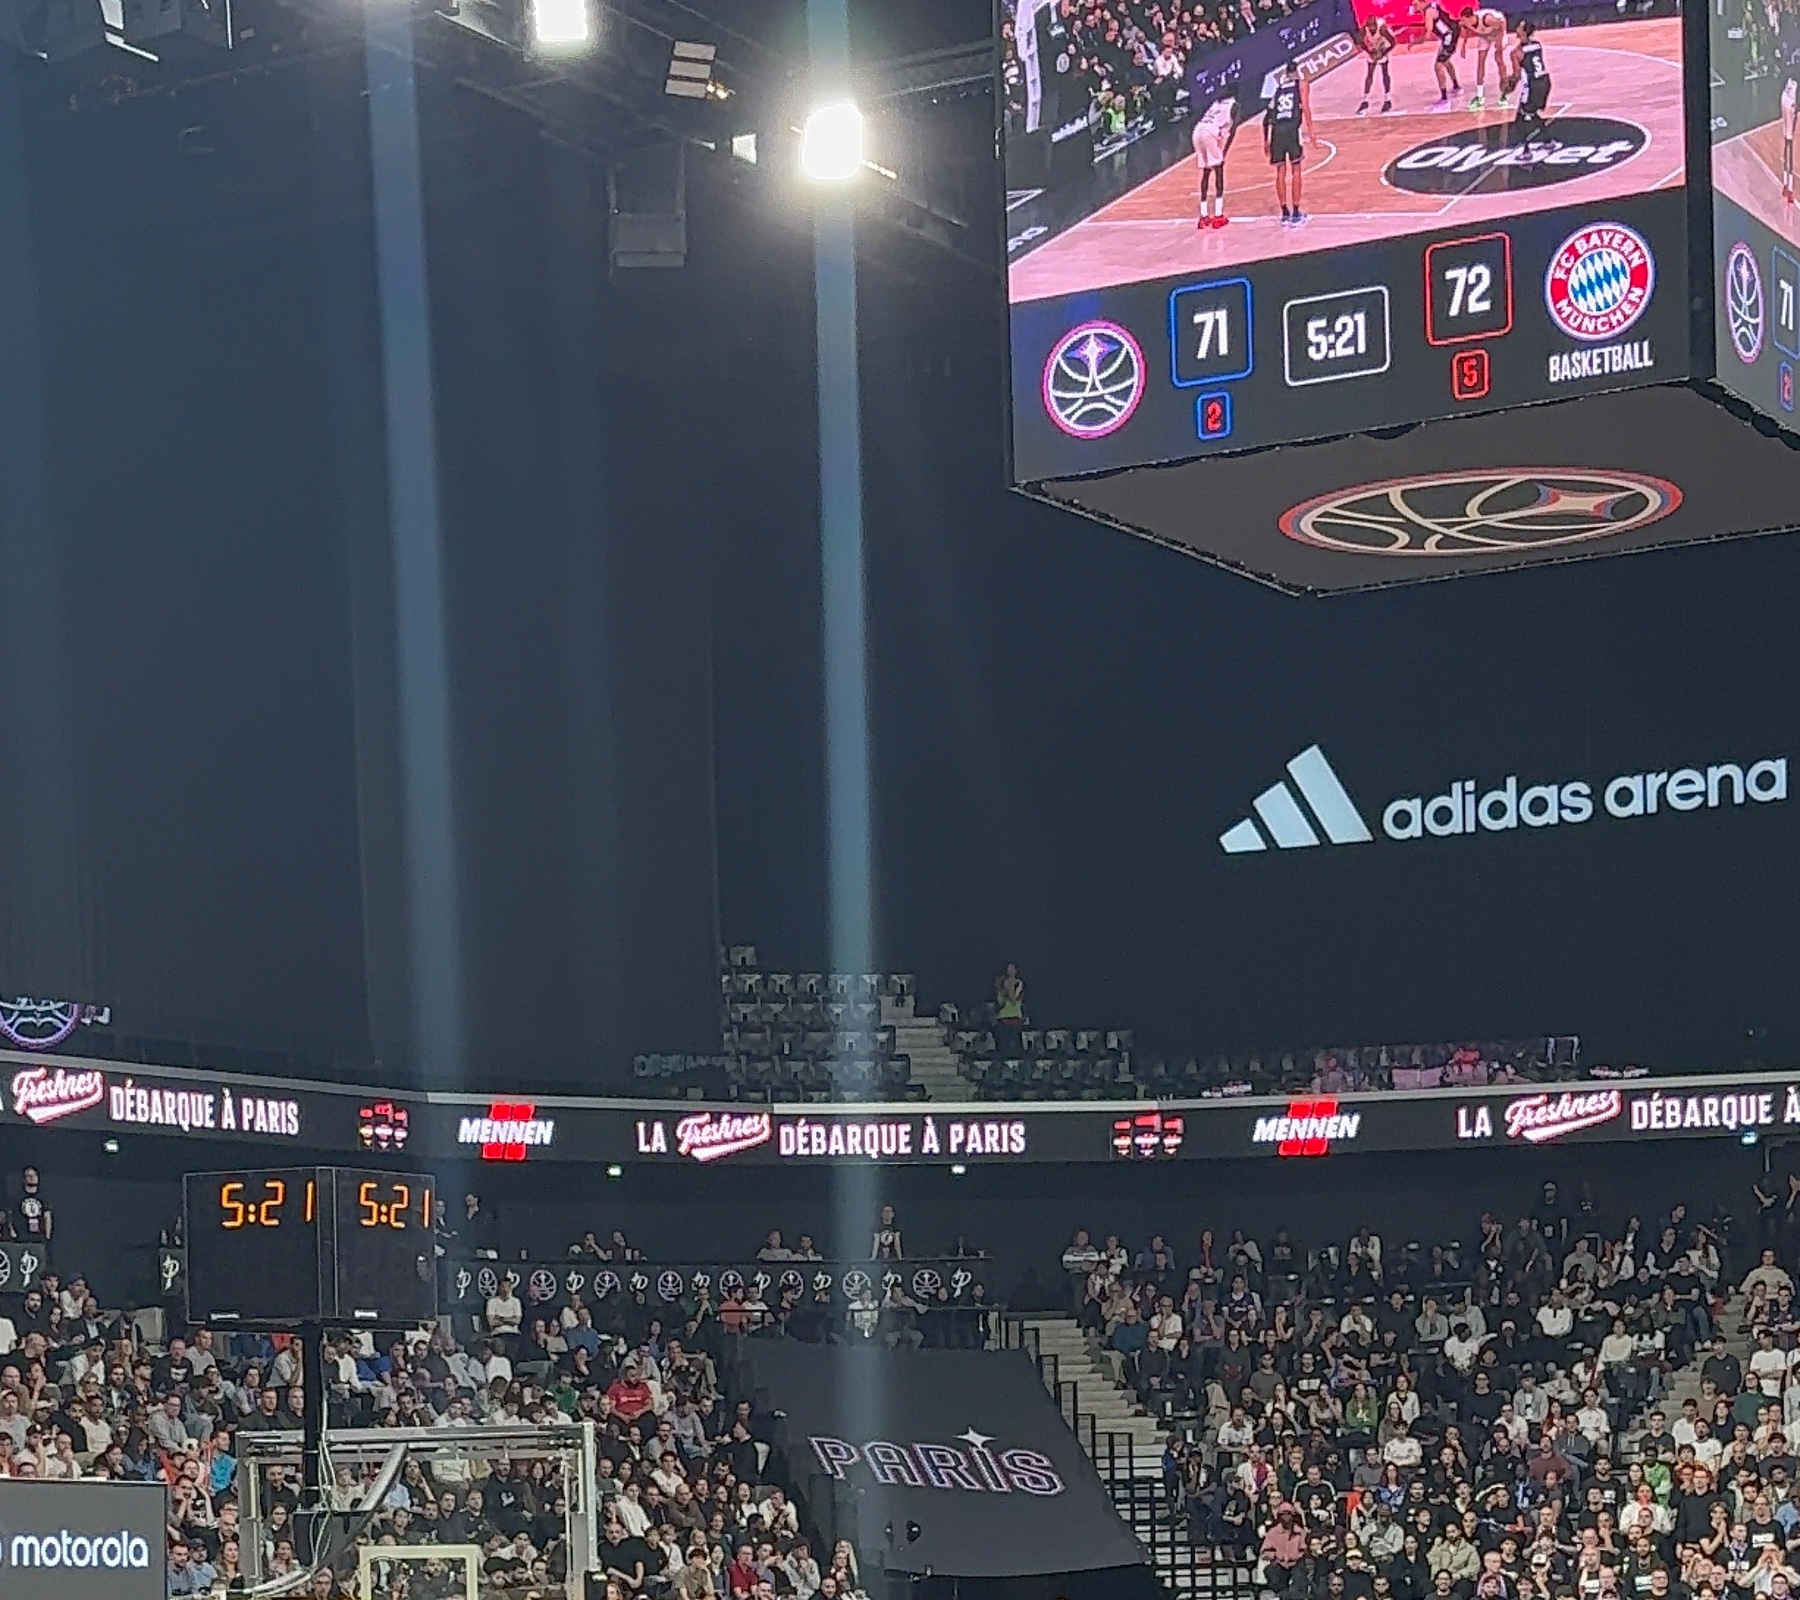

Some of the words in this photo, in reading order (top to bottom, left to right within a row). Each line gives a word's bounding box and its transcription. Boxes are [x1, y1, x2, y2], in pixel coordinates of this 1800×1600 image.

[1553, 253, 1575, 280] FC
[1575, 231, 1645, 268] BAYERN
[1445, 264, 1491, 316] 72
[1779, 278, 1794, 331] 71
[1193, 309, 1228, 360] 71
[1307, 312, 1366, 361] 5:21
[1463, 358, 1478, 387] 5
[1549, 339, 1654, 384] BASKETBALL
[1207, 402, 1222, 431] 2
[1382, 776, 1594, 840] adidas
[1604, 757, 1787, 819] arena
[110, 1080, 215, 1131] DÉBARQUE
[221, 1087, 235, 1129] À
[242, 1099, 299, 1135] PARIS
[458, 1117, 554, 1144] MENNEN
[1252, 1113, 1360, 1142] MENNEN
[1457, 1106, 1492, 1138] LA
[1630, 1089, 1774, 1132] DÉBARQUE
[637, 1121, 667, 1153] LA
[779, 1116, 912, 1159] DÉBARQUE
[922, 1116, 940, 1155] À
[949, 1122, 1026, 1154] PARIS
[359, 1182, 431, 1229] 5:21
[807, 1430, 1067, 1496] PARIS
[10, 1530, 149, 1569] motorola
